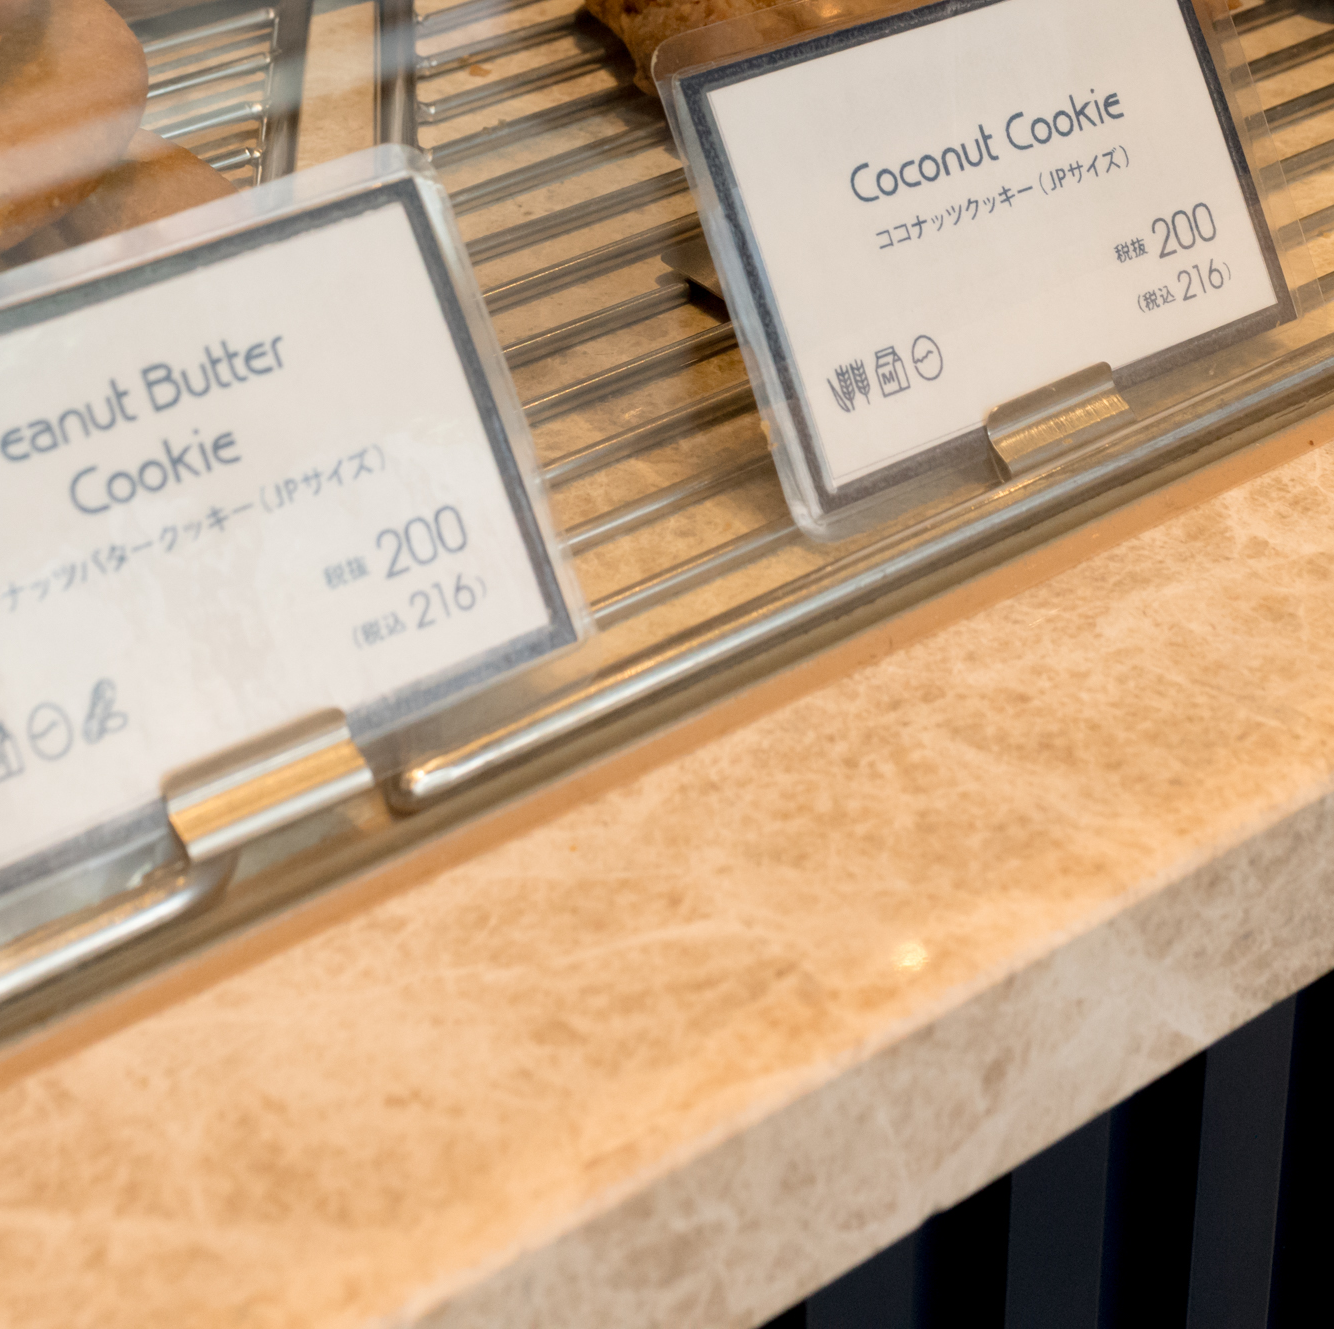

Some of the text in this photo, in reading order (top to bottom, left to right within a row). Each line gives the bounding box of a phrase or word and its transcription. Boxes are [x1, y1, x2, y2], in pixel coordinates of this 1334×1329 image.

[850, 88, 1125, 203] Coconut Cookie
[1114, 201, 1218, 264] 税抜 200
[143, 332, 287, 414] Butter
[68, 428, 242, 515] Cookie
[323, 504, 469, 590] 税抜 200
